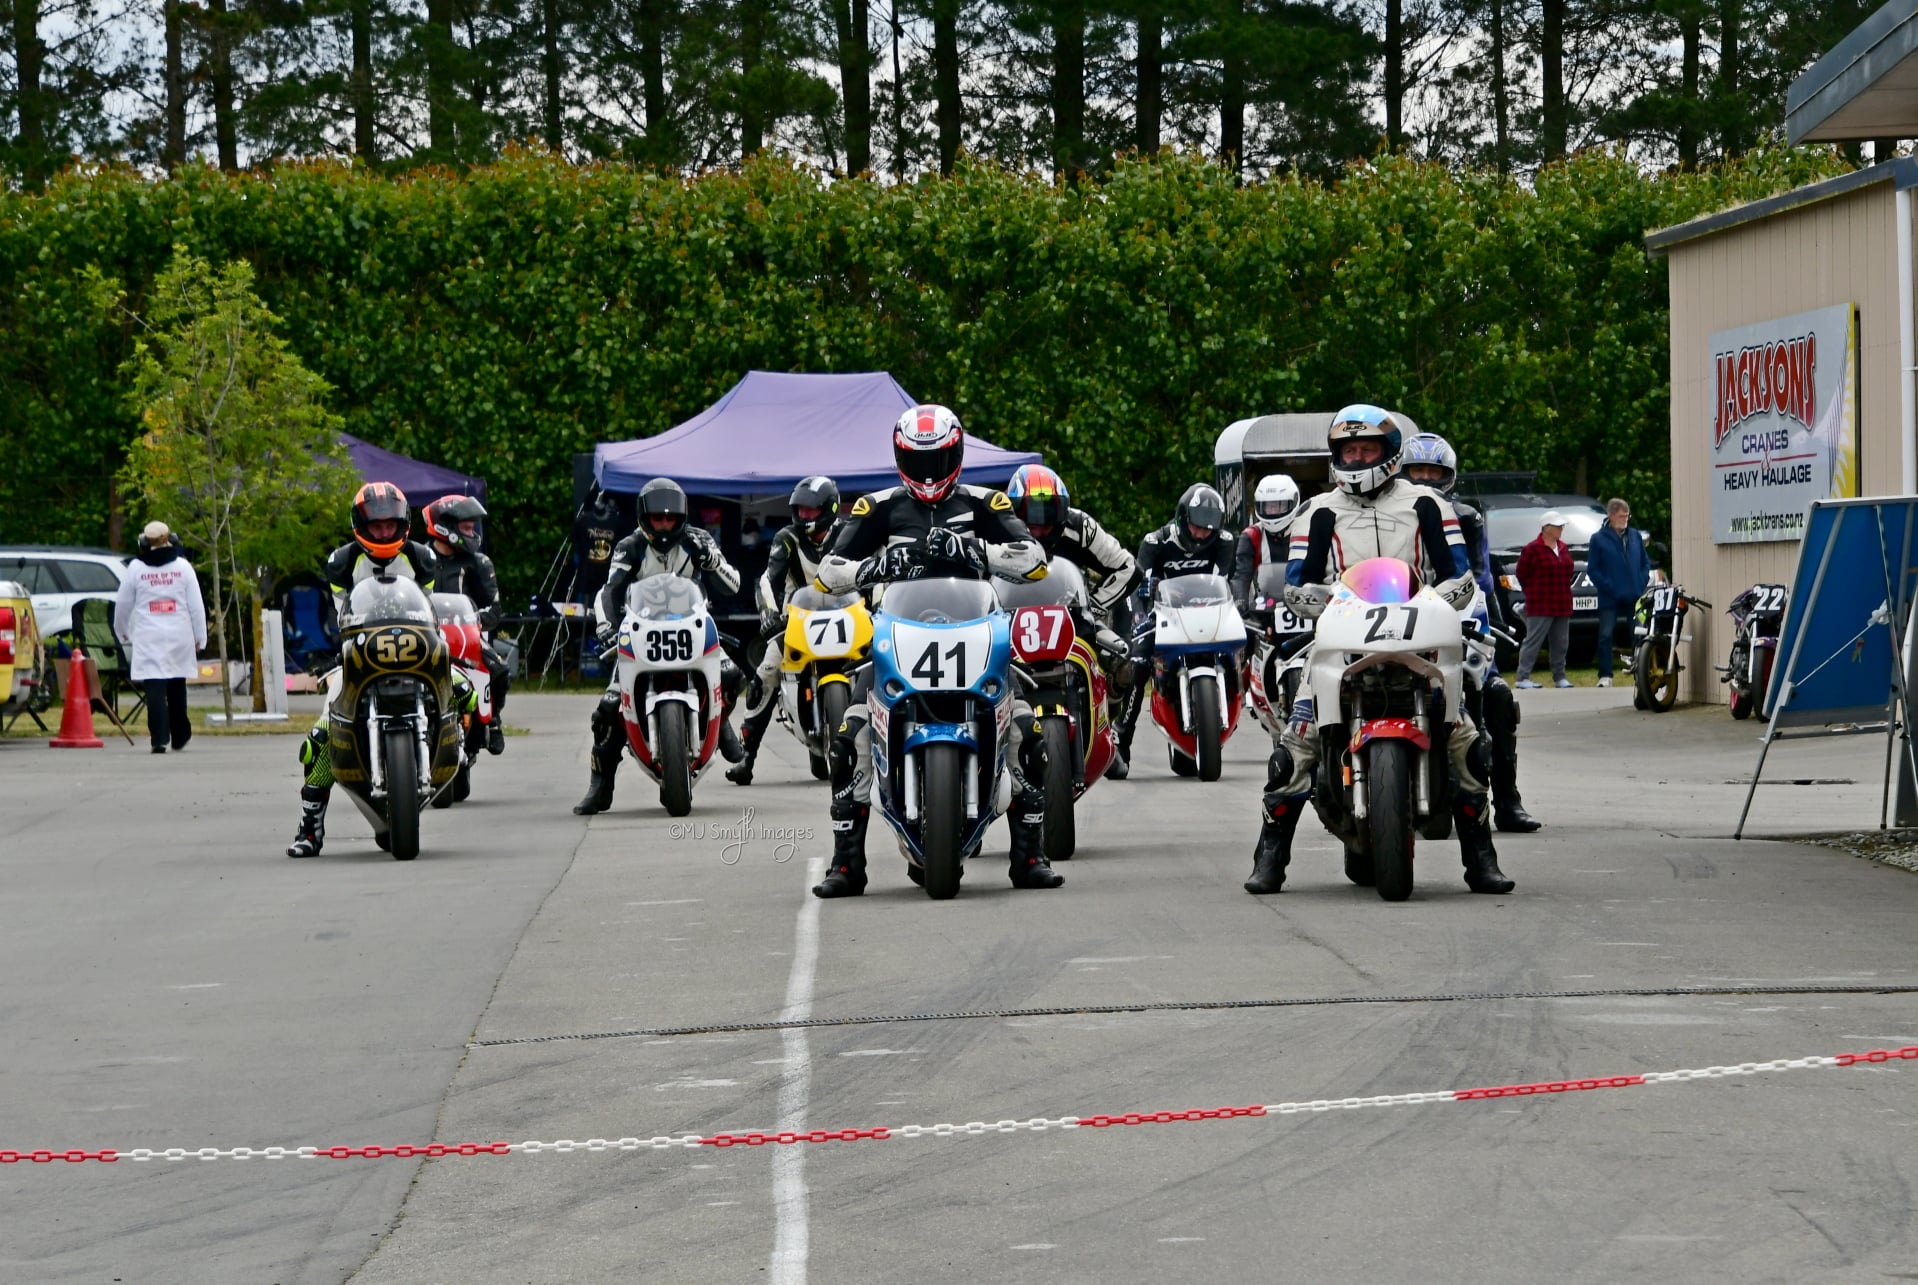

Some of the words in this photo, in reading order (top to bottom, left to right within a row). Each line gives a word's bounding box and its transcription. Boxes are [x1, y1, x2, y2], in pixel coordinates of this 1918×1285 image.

[1714, 331, 1816, 450] JACKSONS
[1742, 429, 1789, 454] CRANES
[1724, 470, 1758, 490] HEAVY
[1762, 464, 1812, 487] HAULAGE
[1731, 511, 1803, 535] www.jacktrans.co.nz
[1653, 587, 1675, 611] 87
[1752, 588, 1784, 611] 22
[809, 618, 847, 646] 71
[1020, 610, 1064, 653] 37
[1364, 606, 1419, 644] 27
[376, 634, 418, 663] 52
[646, 629, 693, 662] 359
[911, 641, 966, 688] 41
[834, 771, 864, 800] TAICHI
